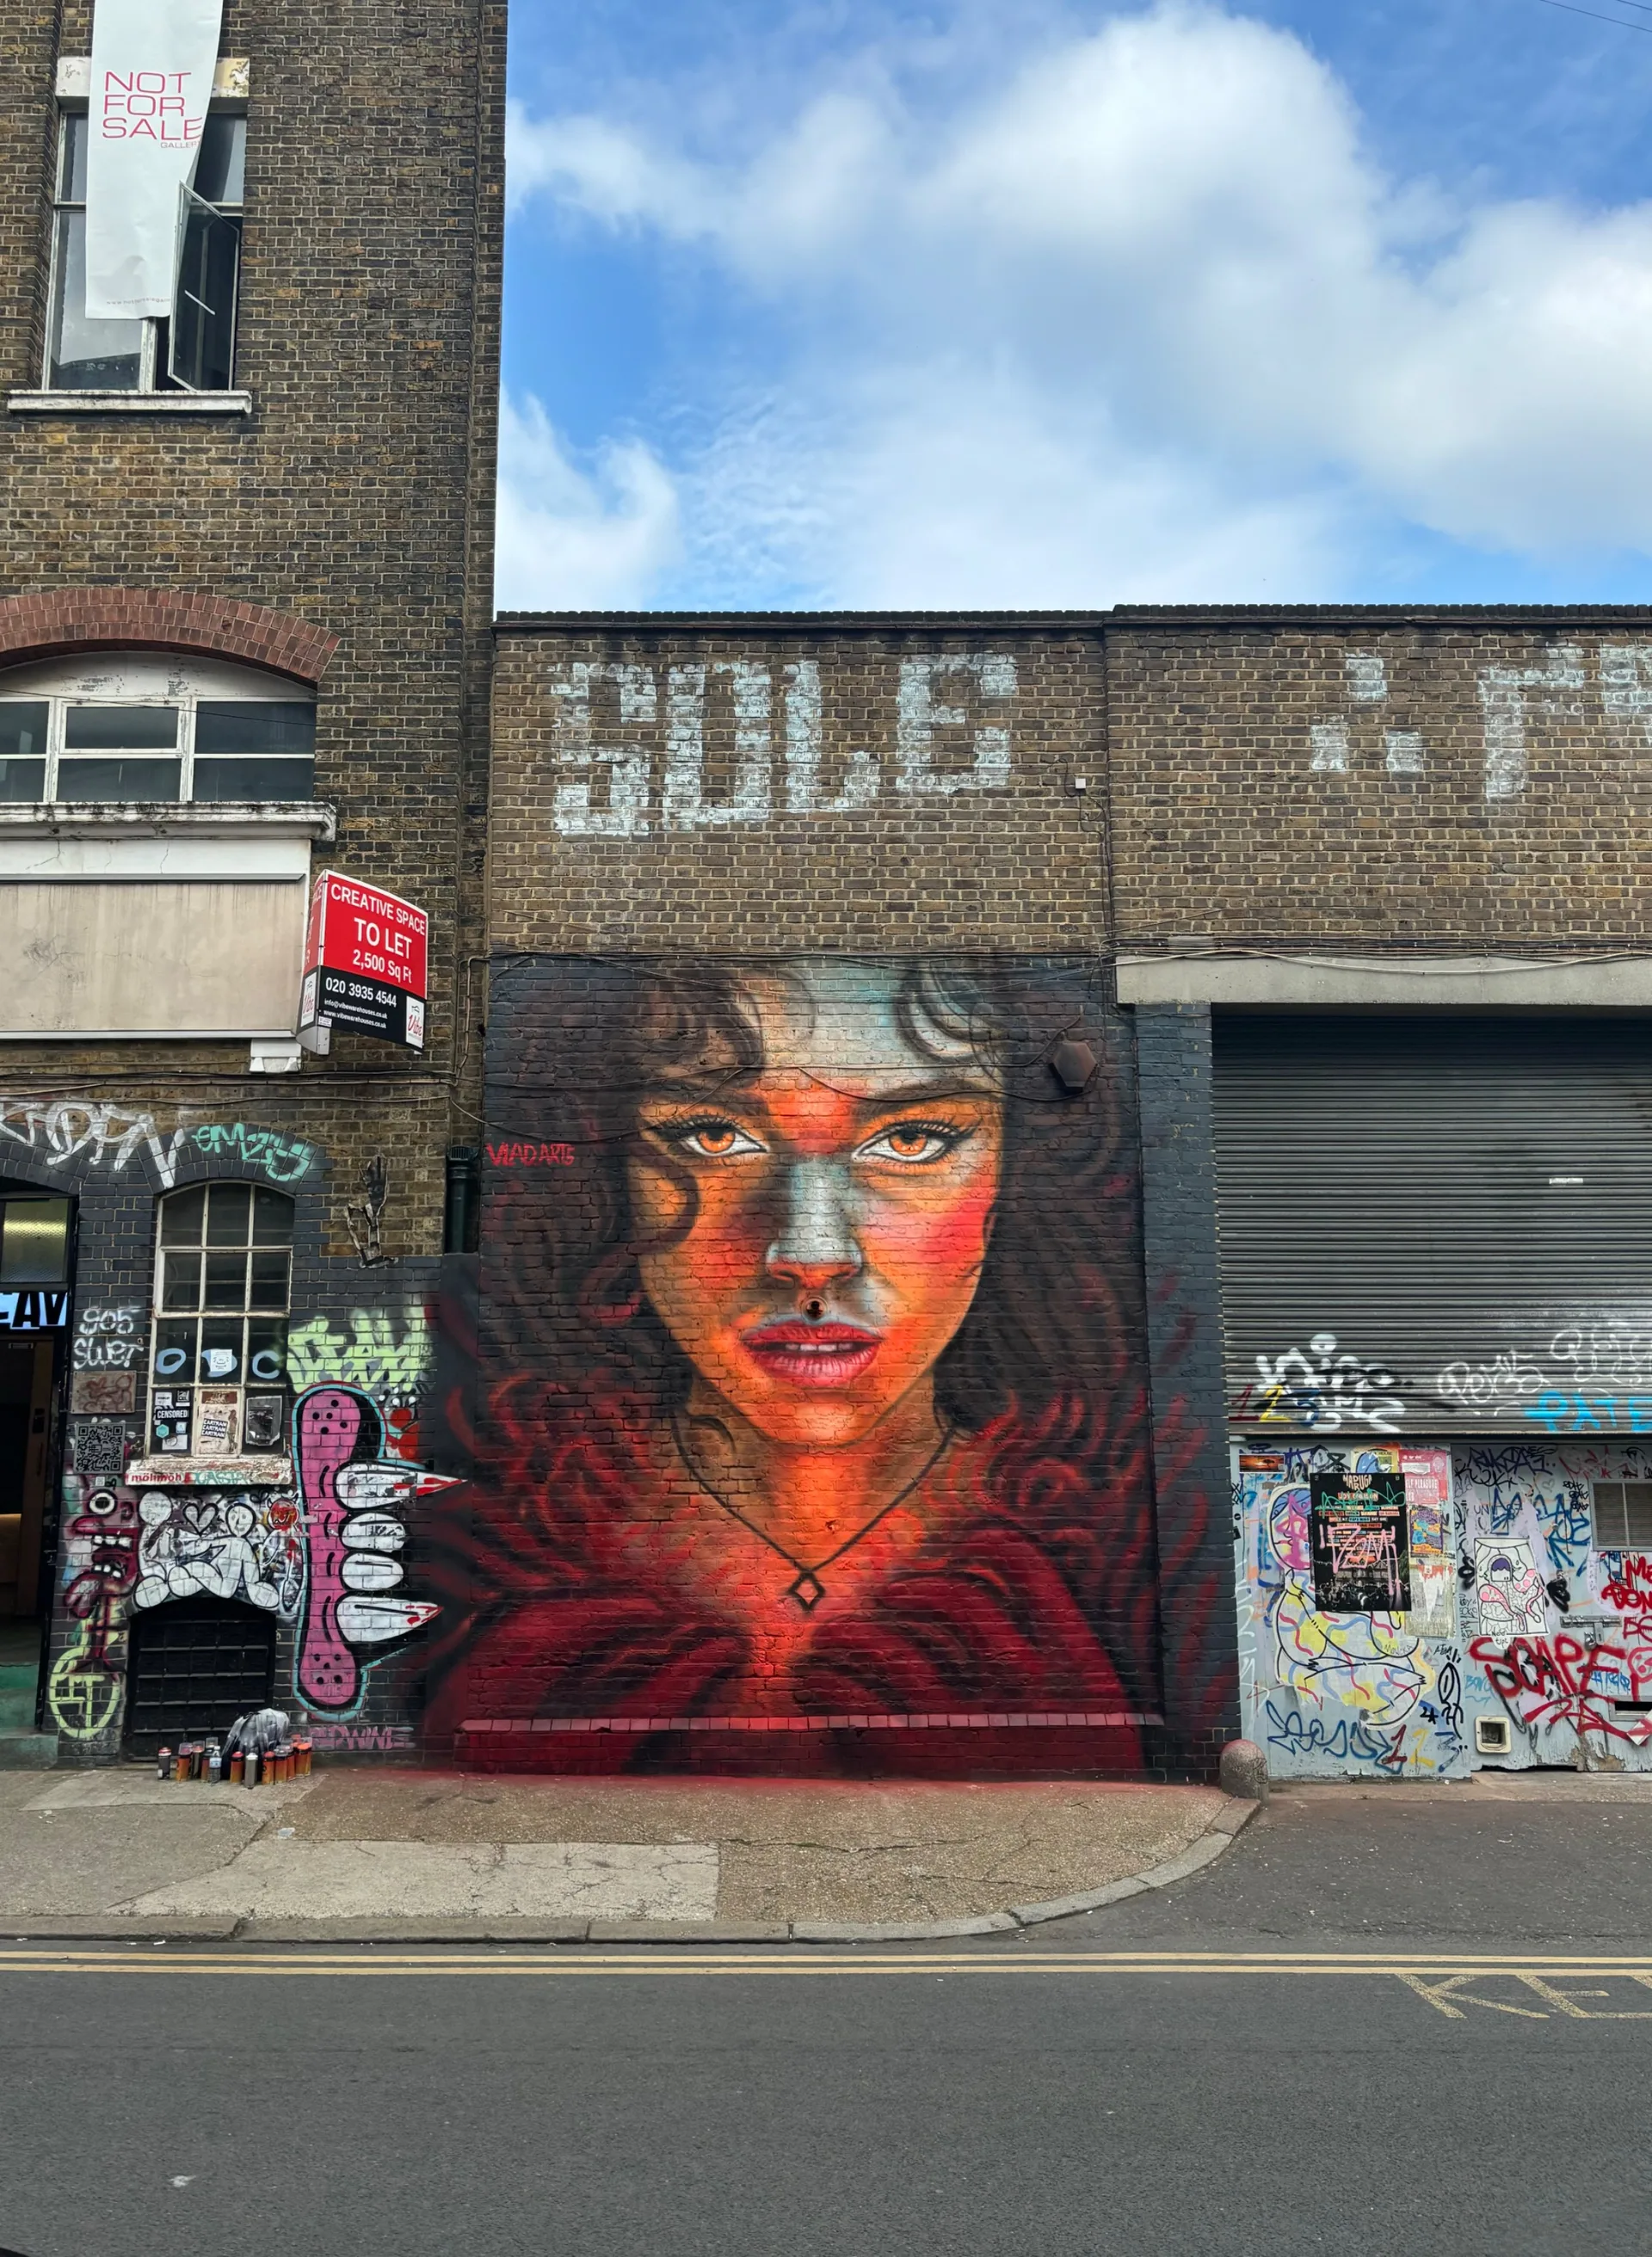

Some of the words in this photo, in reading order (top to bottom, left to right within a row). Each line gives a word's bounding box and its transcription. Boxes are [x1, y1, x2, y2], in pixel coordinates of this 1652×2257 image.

[105, 71, 192, 93] NOT
[103, 95, 186, 117] FOR
[102, 116, 203, 140] SALE
[330, 884, 394, 920] CREATIVE
[396, 908, 426, 936] SPACE
[354, 917, 380, 947] TO
[385, 928, 412, 959] LET
[353, 949, 385, 973] 2,500
[387, 959, 401, 983] Sq
[403, 966, 412, 984] Ft
[325, 977, 346, 994] 020
[348, 983, 373, 1001] 3935
[376, 990, 397, 1008] 4544
